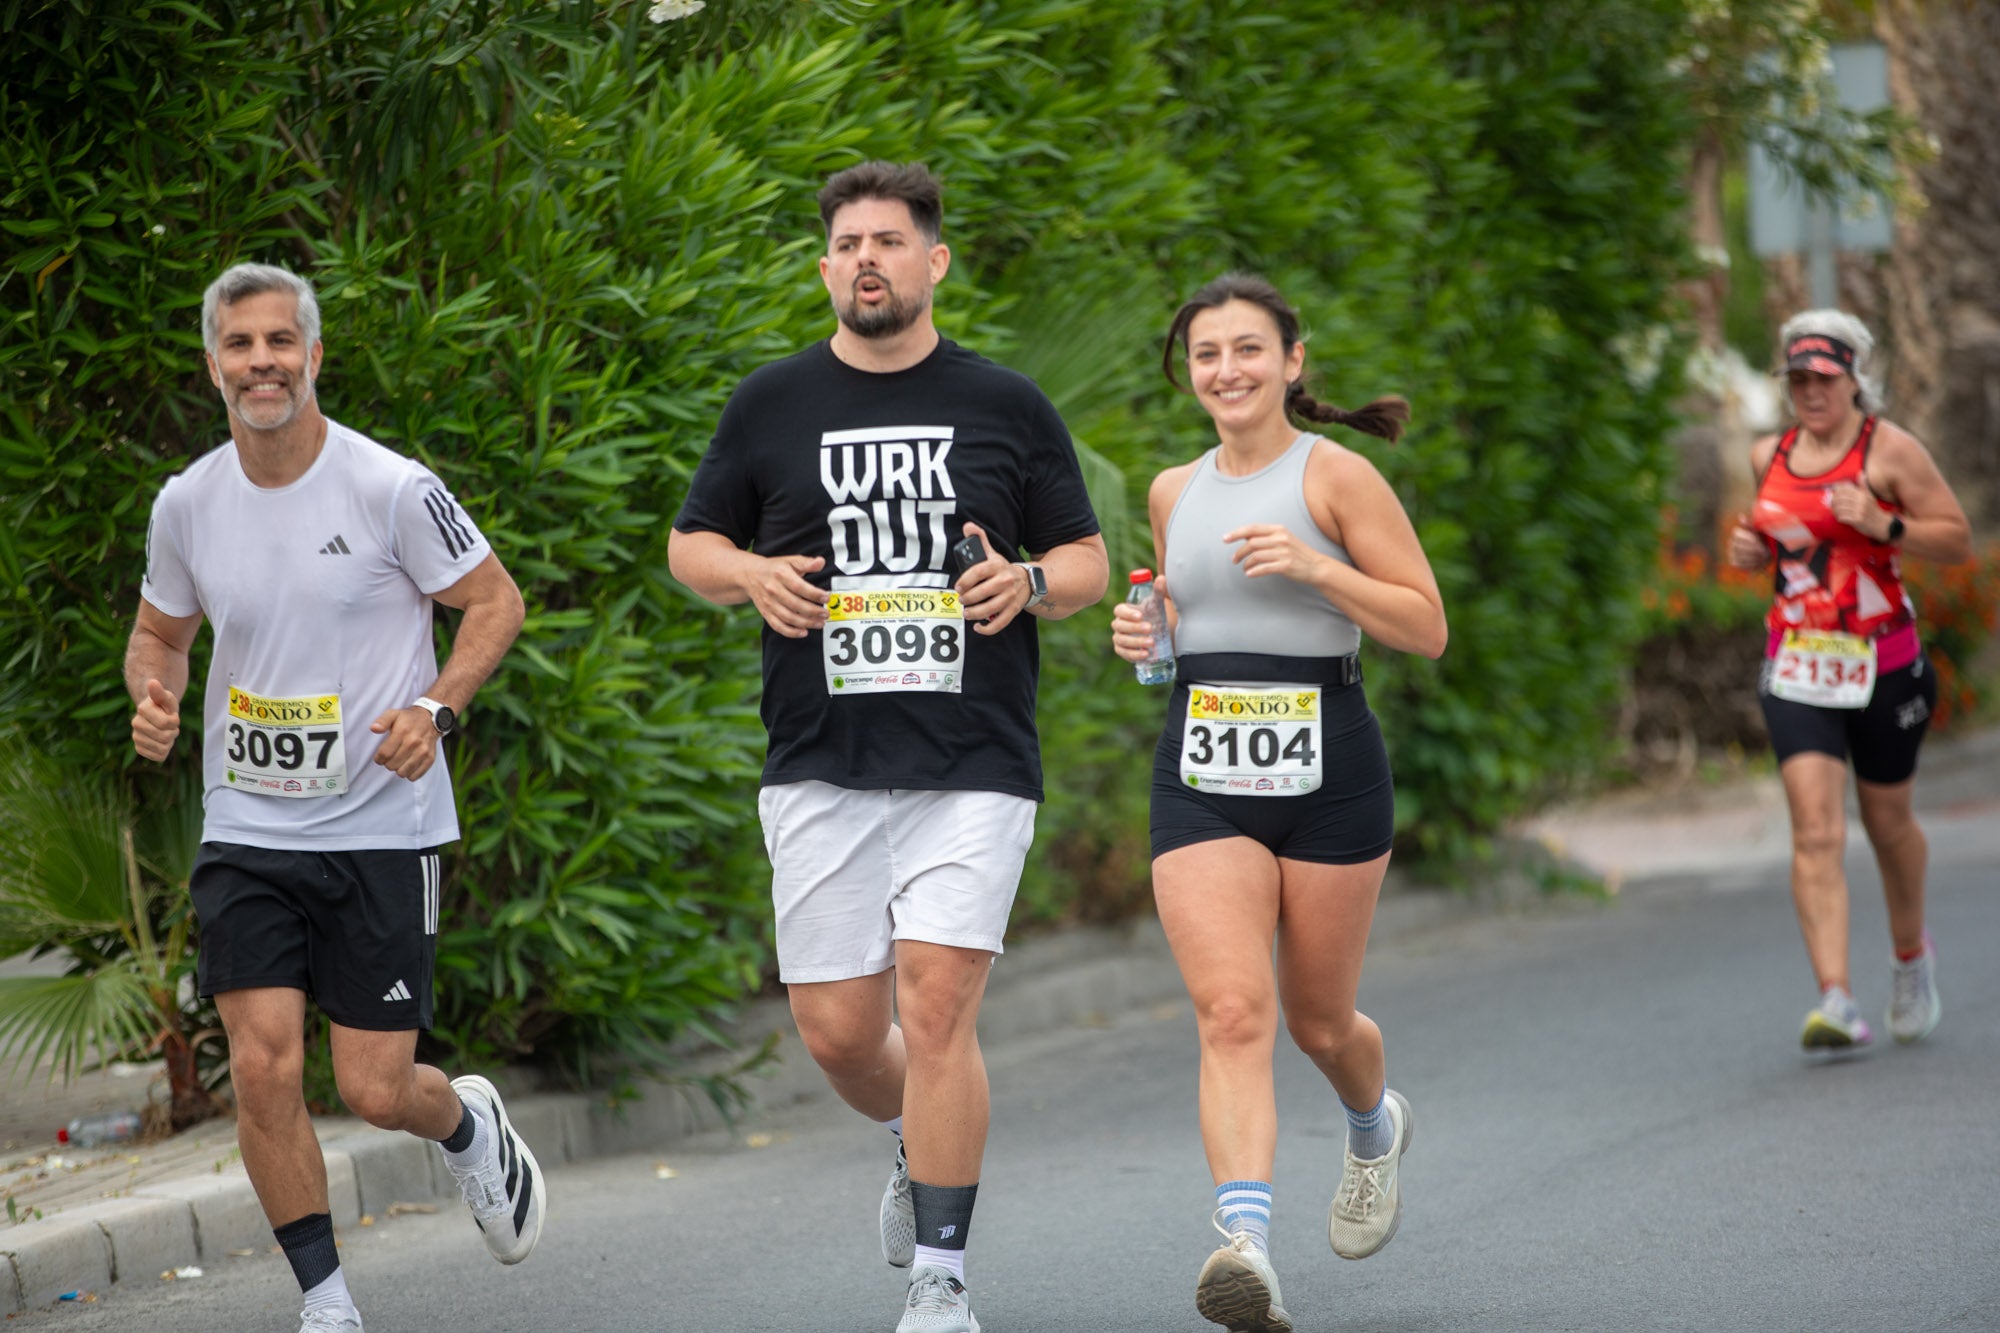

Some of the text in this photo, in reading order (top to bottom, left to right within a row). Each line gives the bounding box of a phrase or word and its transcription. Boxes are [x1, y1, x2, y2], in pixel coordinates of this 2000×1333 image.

[820, 440, 957, 504] WRK
[827, 499, 957, 575] OUT
[843, 595, 864, 613] 38
[865, 600, 935, 613] FONDO
[829, 624, 960, 666] 3098
[1780, 653, 1867, 690] 2134
[238, 694, 250, 714] 38
[250, 703, 312, 720] FONDO
[252, 698, 270, 707] GRAN
[1202, 694, 1219, 712] 38
[1219, 701, 1290, 715] FONDO
[228, 723, 338, 770] 3097
[1188, 725, 1316, 768] 3104
[1200, 777, 1227, 785] Cruzcampo
